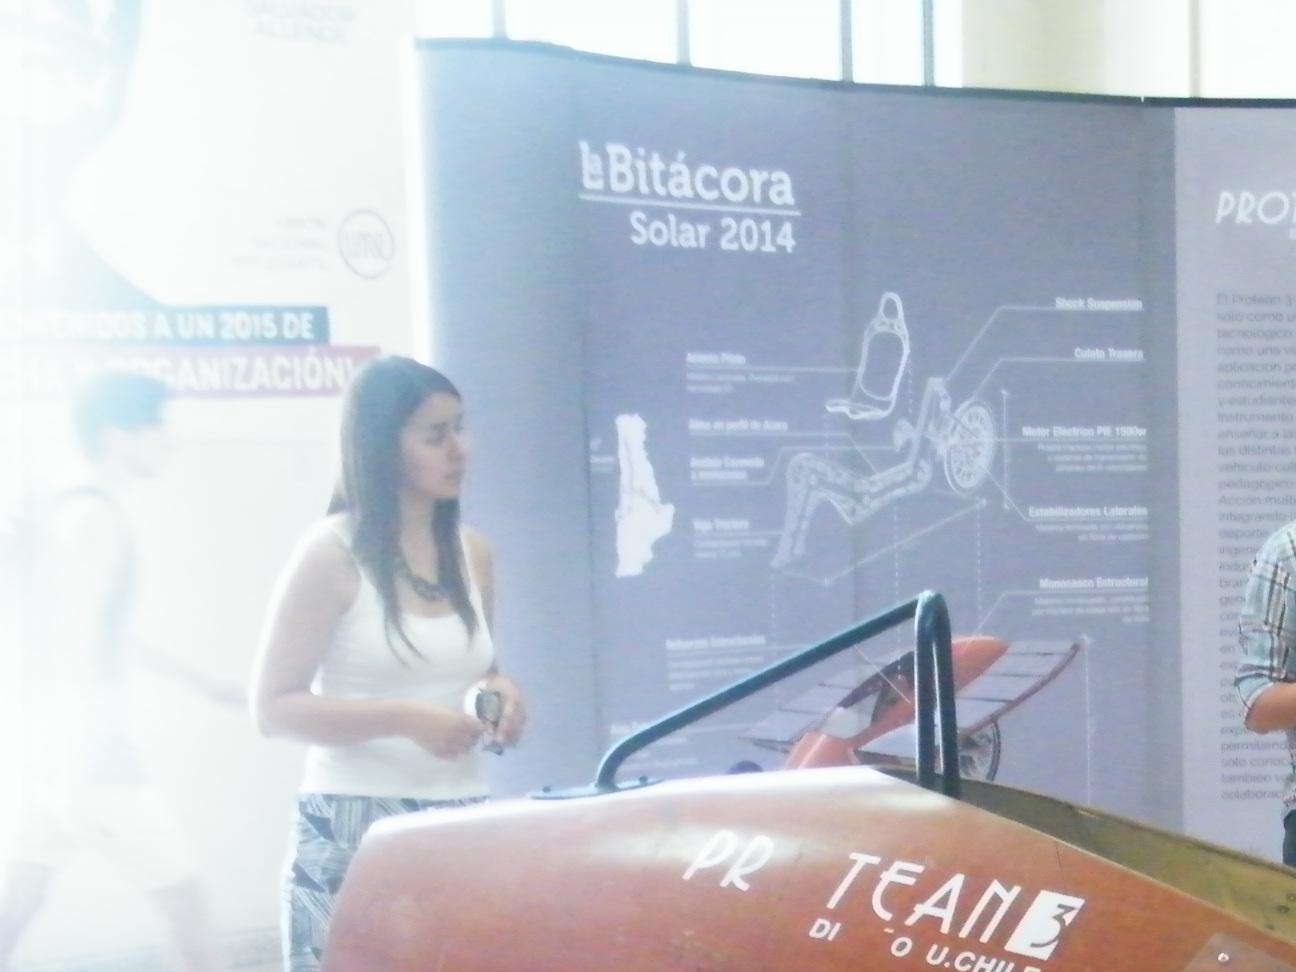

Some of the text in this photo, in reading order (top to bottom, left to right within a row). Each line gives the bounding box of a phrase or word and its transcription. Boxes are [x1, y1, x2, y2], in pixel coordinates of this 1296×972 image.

[606, 143, 795, 206] Bitácora
[630, 210, 796, 255] Solar 2014
[176, 312, 216, 339] UN
[220, 312, 276, 340] 2015
[281, 312, 315, 340] DE
